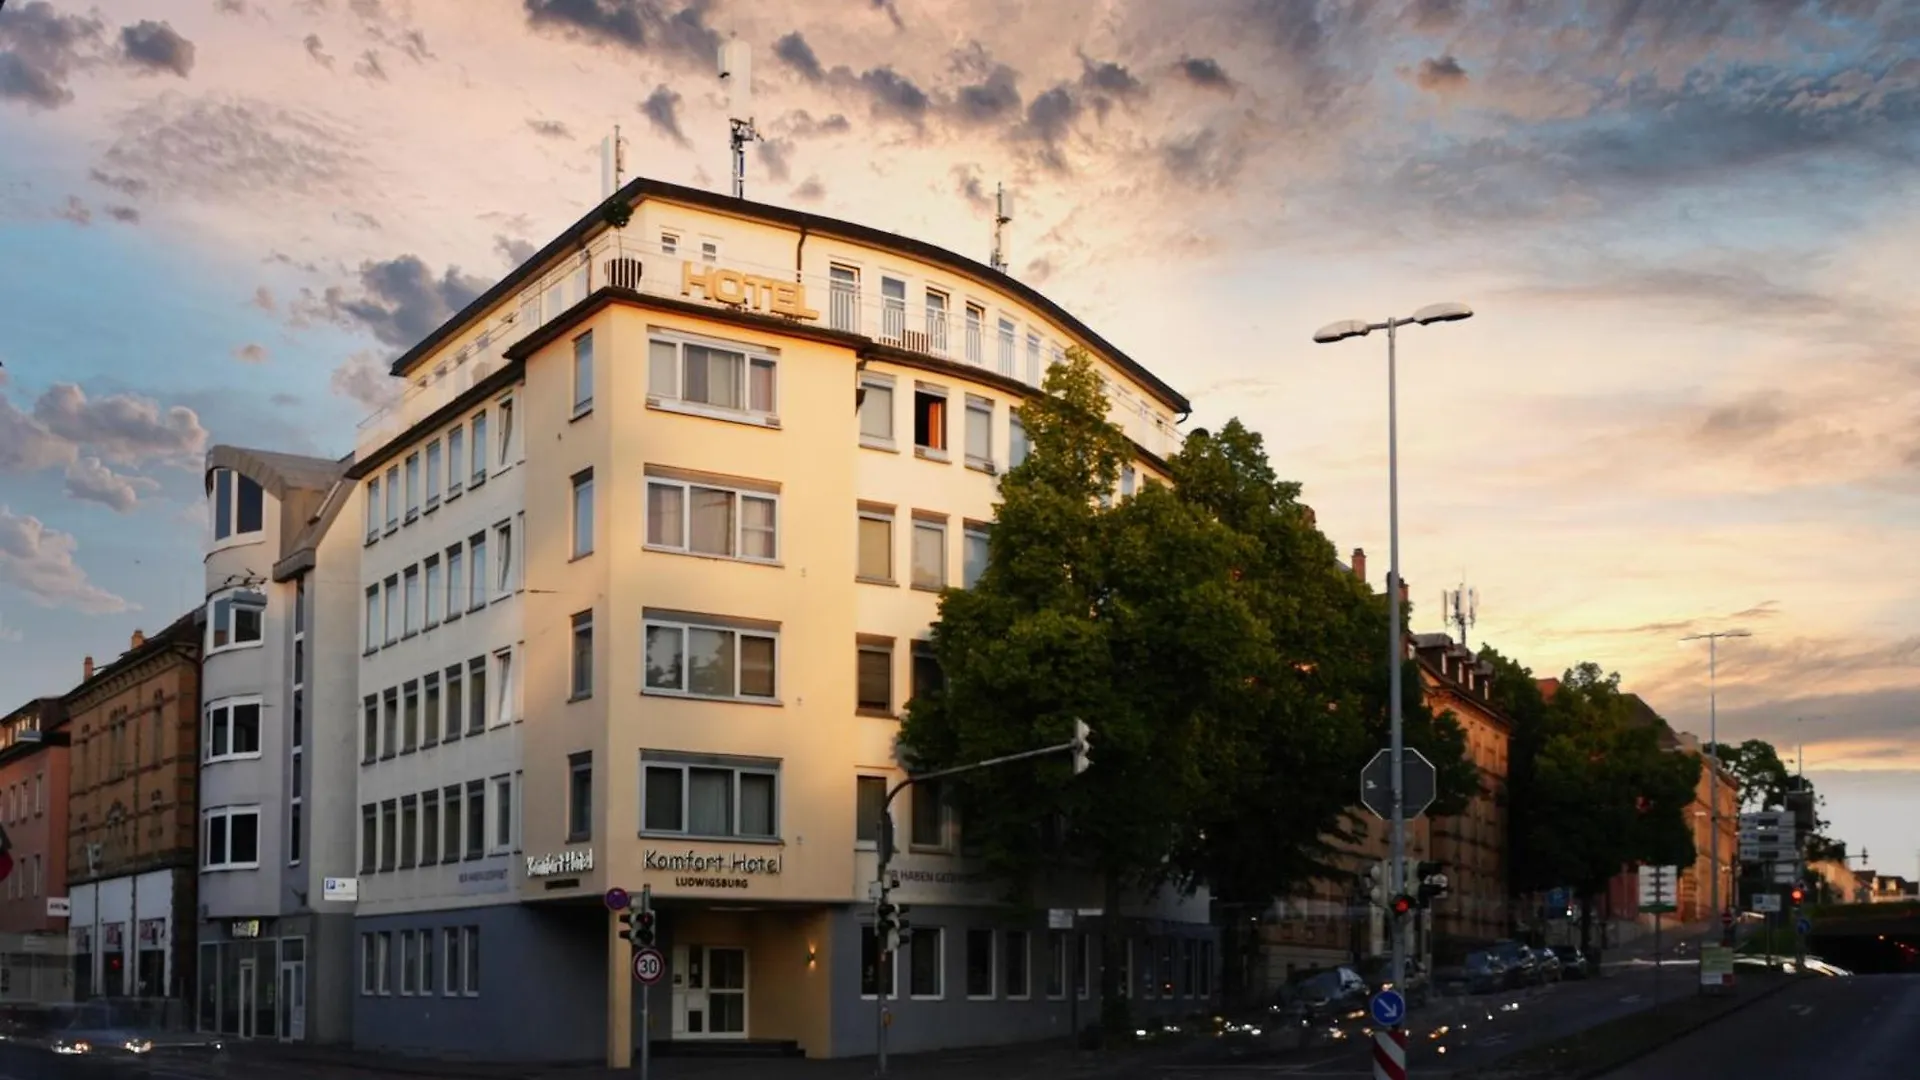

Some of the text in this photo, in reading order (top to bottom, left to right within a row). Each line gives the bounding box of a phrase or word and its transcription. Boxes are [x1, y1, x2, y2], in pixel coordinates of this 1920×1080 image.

[681, 261, 820, 320] HOTEL
[644, 850, 782, 874] Komfort Hotel
[675, 876, 749, 889] LUDWIGSBURG
[639, 958, 658, 975] 30
